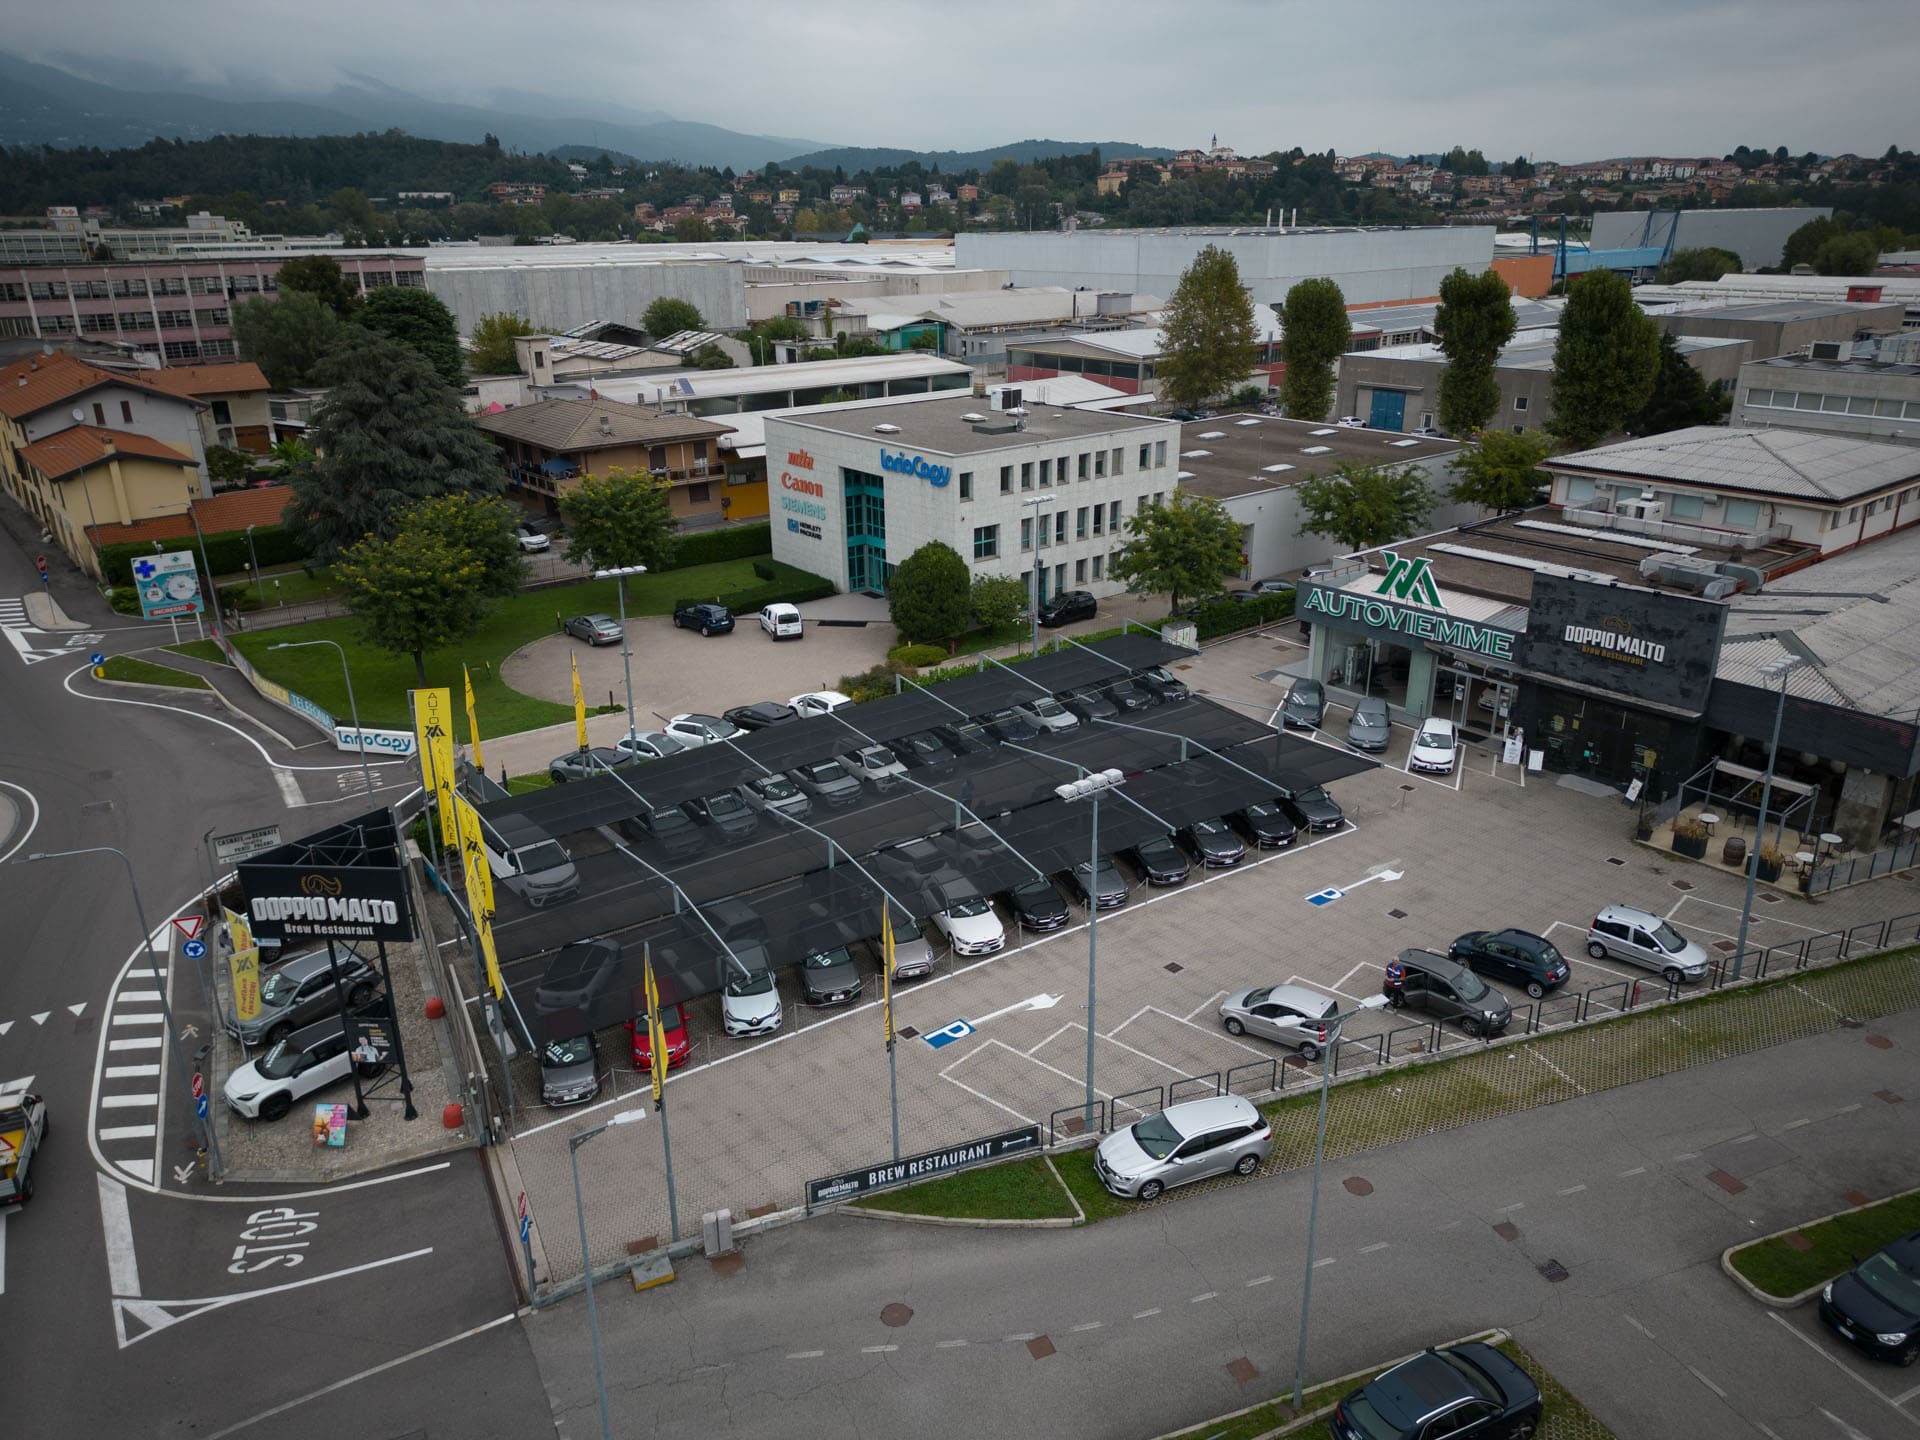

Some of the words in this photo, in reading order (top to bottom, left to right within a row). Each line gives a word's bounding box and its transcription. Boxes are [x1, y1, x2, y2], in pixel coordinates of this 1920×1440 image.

[788, 448, 814, 470] mita
[781, 472, 823, 497] Canon
[781, 496, 826, 520] SIEMENS
[800, 521, 822, 533] HEWLETT
[1304, 588, 1515, 660] AUTOVIEMME
[1565, 625, 1615, 649] DOPPIO
[1616, 634, 1666, 662] MALTO
[1581, 645, 1600, 656] Brew
[1601, 648, 1644, 666] Restaurant
[428, 692, 439, 724] AUTO
[251, 897, 328, 921] DOPPIO
[328, 898, 399, 925] MALTO
[285, 923, 311, 934] Brew
[314, 924, 374, 936] Restaurant
[869, 1164, 905, 1186] BREW
[909, 1142, 992, 1174] RESTAURANT
[227, 1207, 320, 1274] STOP
